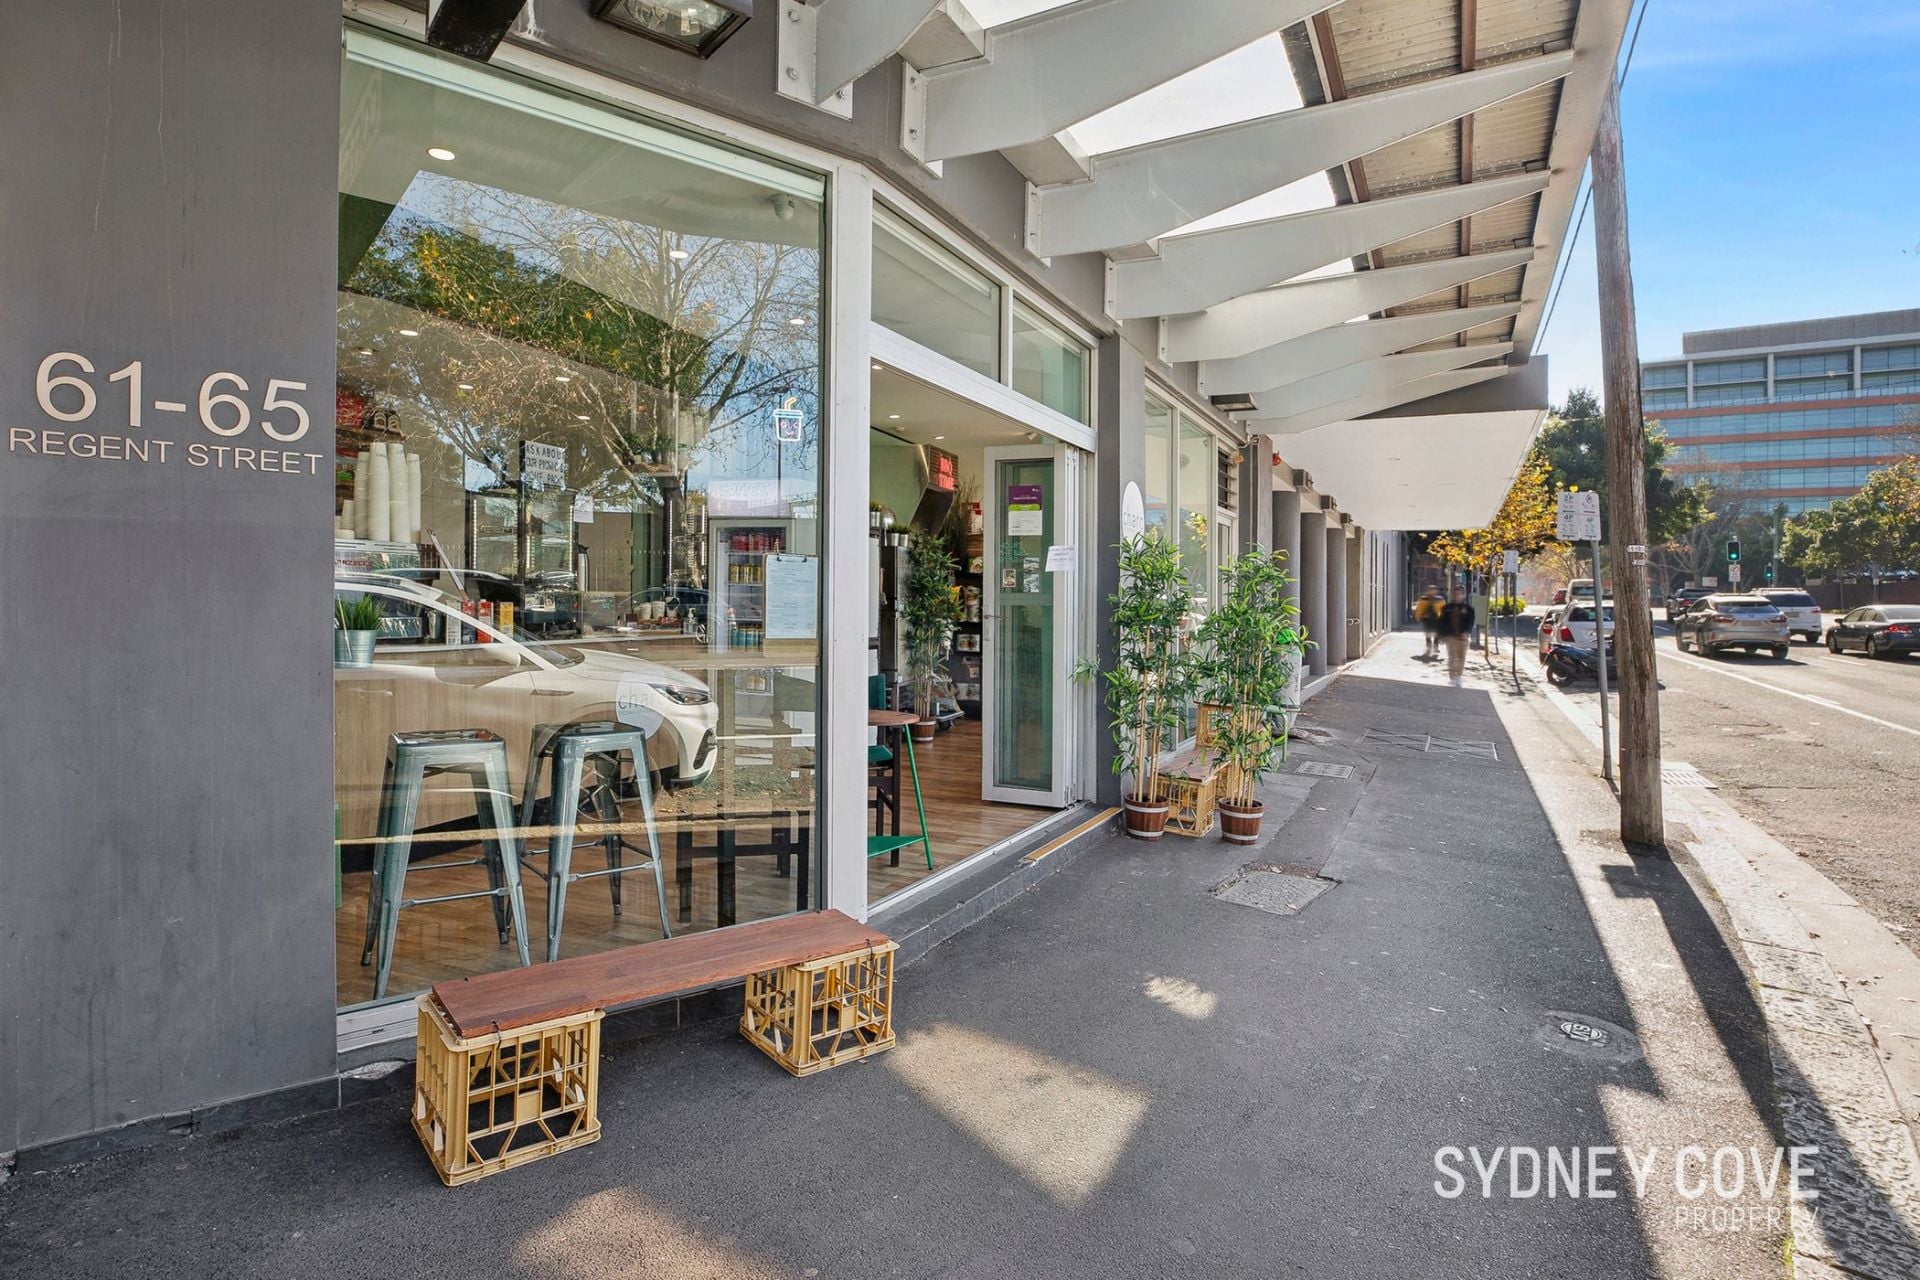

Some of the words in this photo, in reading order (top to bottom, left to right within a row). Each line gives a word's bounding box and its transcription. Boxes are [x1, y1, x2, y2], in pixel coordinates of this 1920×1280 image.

[35, 351, 310, 442] 61-65
[9, 427, 174, 463] REGENT
[187, 443, 323, 475] STREET
[542, 447, 564, 460] ABOU
